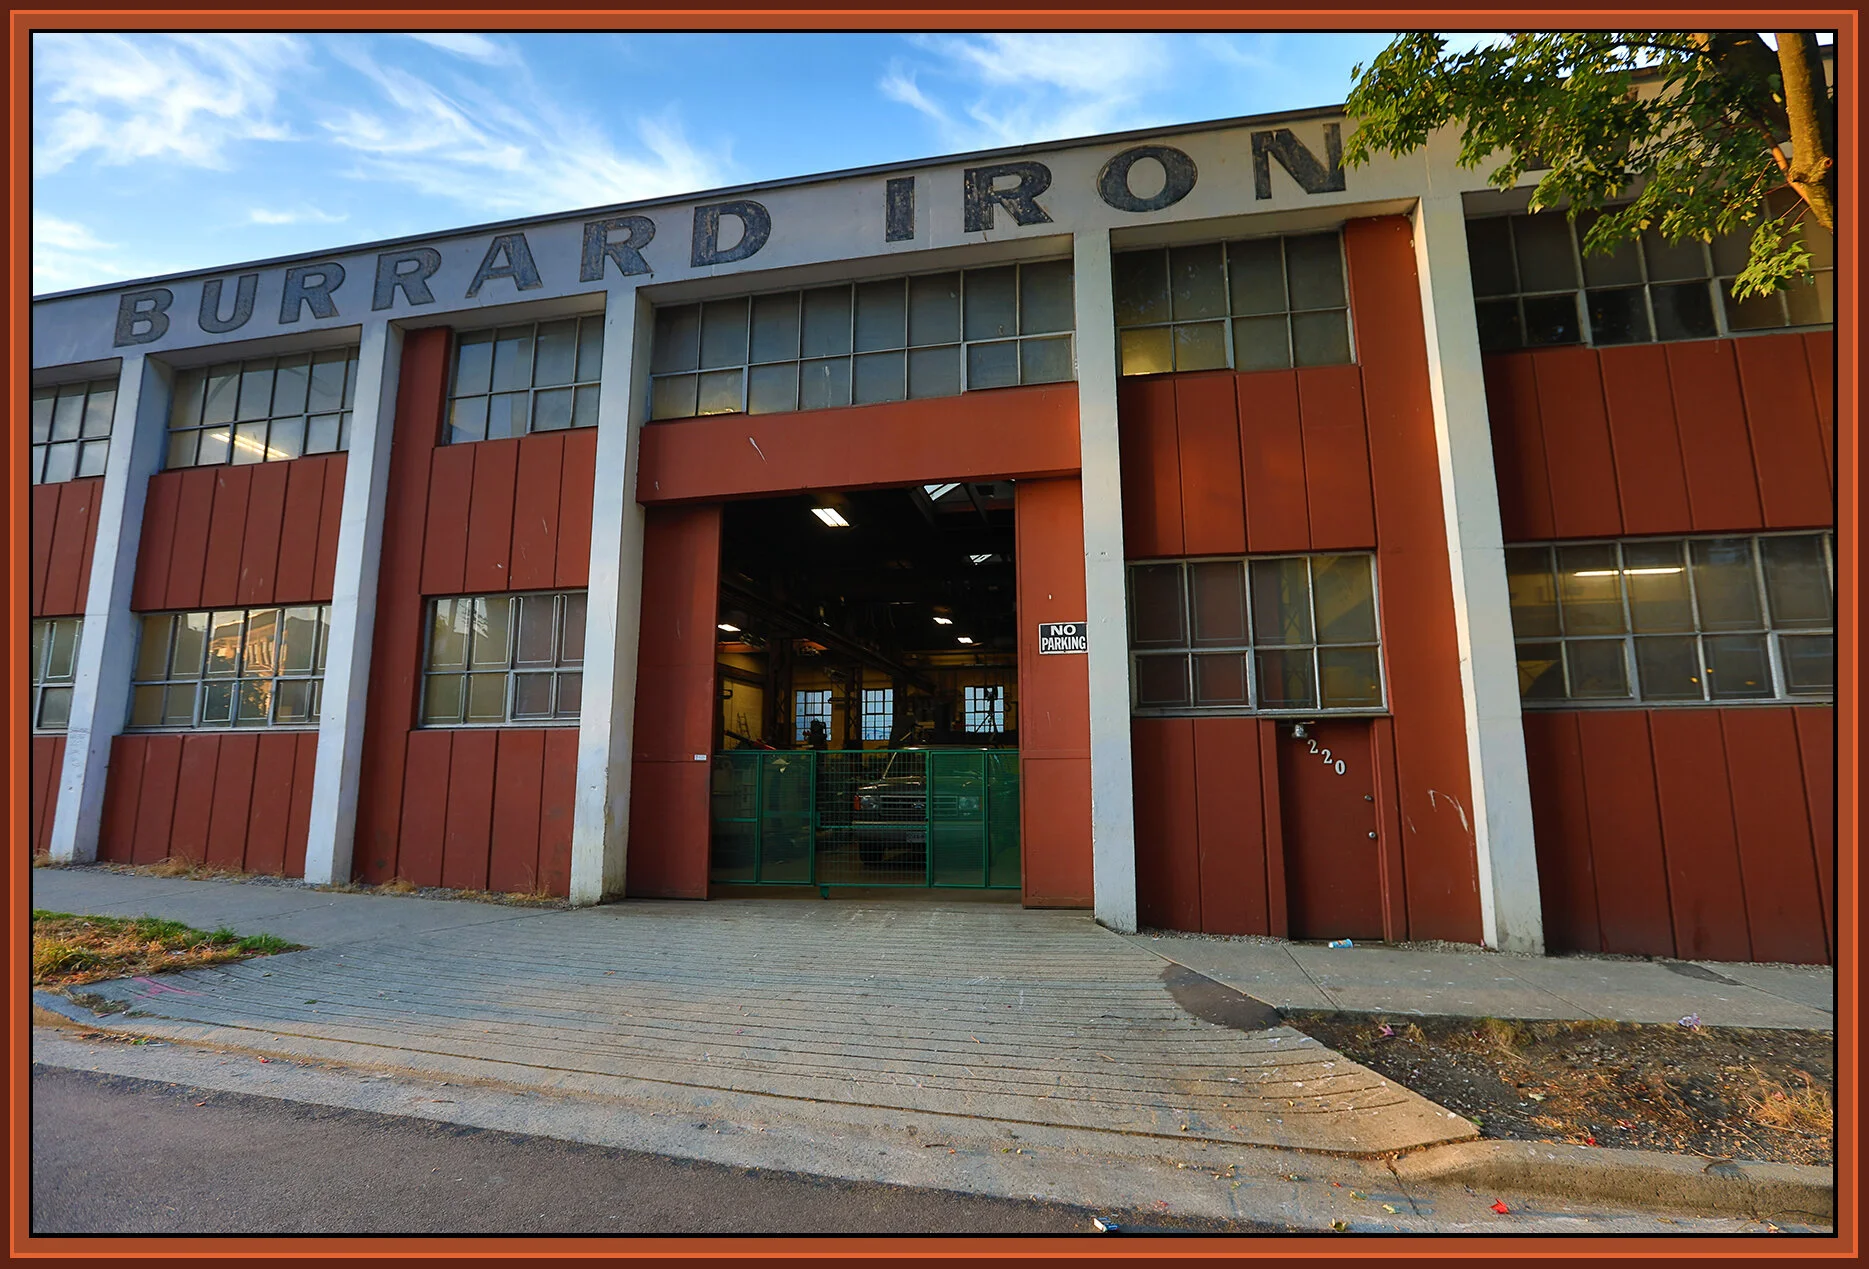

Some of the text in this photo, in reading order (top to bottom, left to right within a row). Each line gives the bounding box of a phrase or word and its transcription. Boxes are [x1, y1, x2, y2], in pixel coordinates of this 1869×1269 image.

[113, 122, 1347, 348] BURRARD IRON
[1050, 624, 1077, 636] NO
[1041, 636, 1086, 651] PARKING
[1307, 739, 1346, 775] 220
